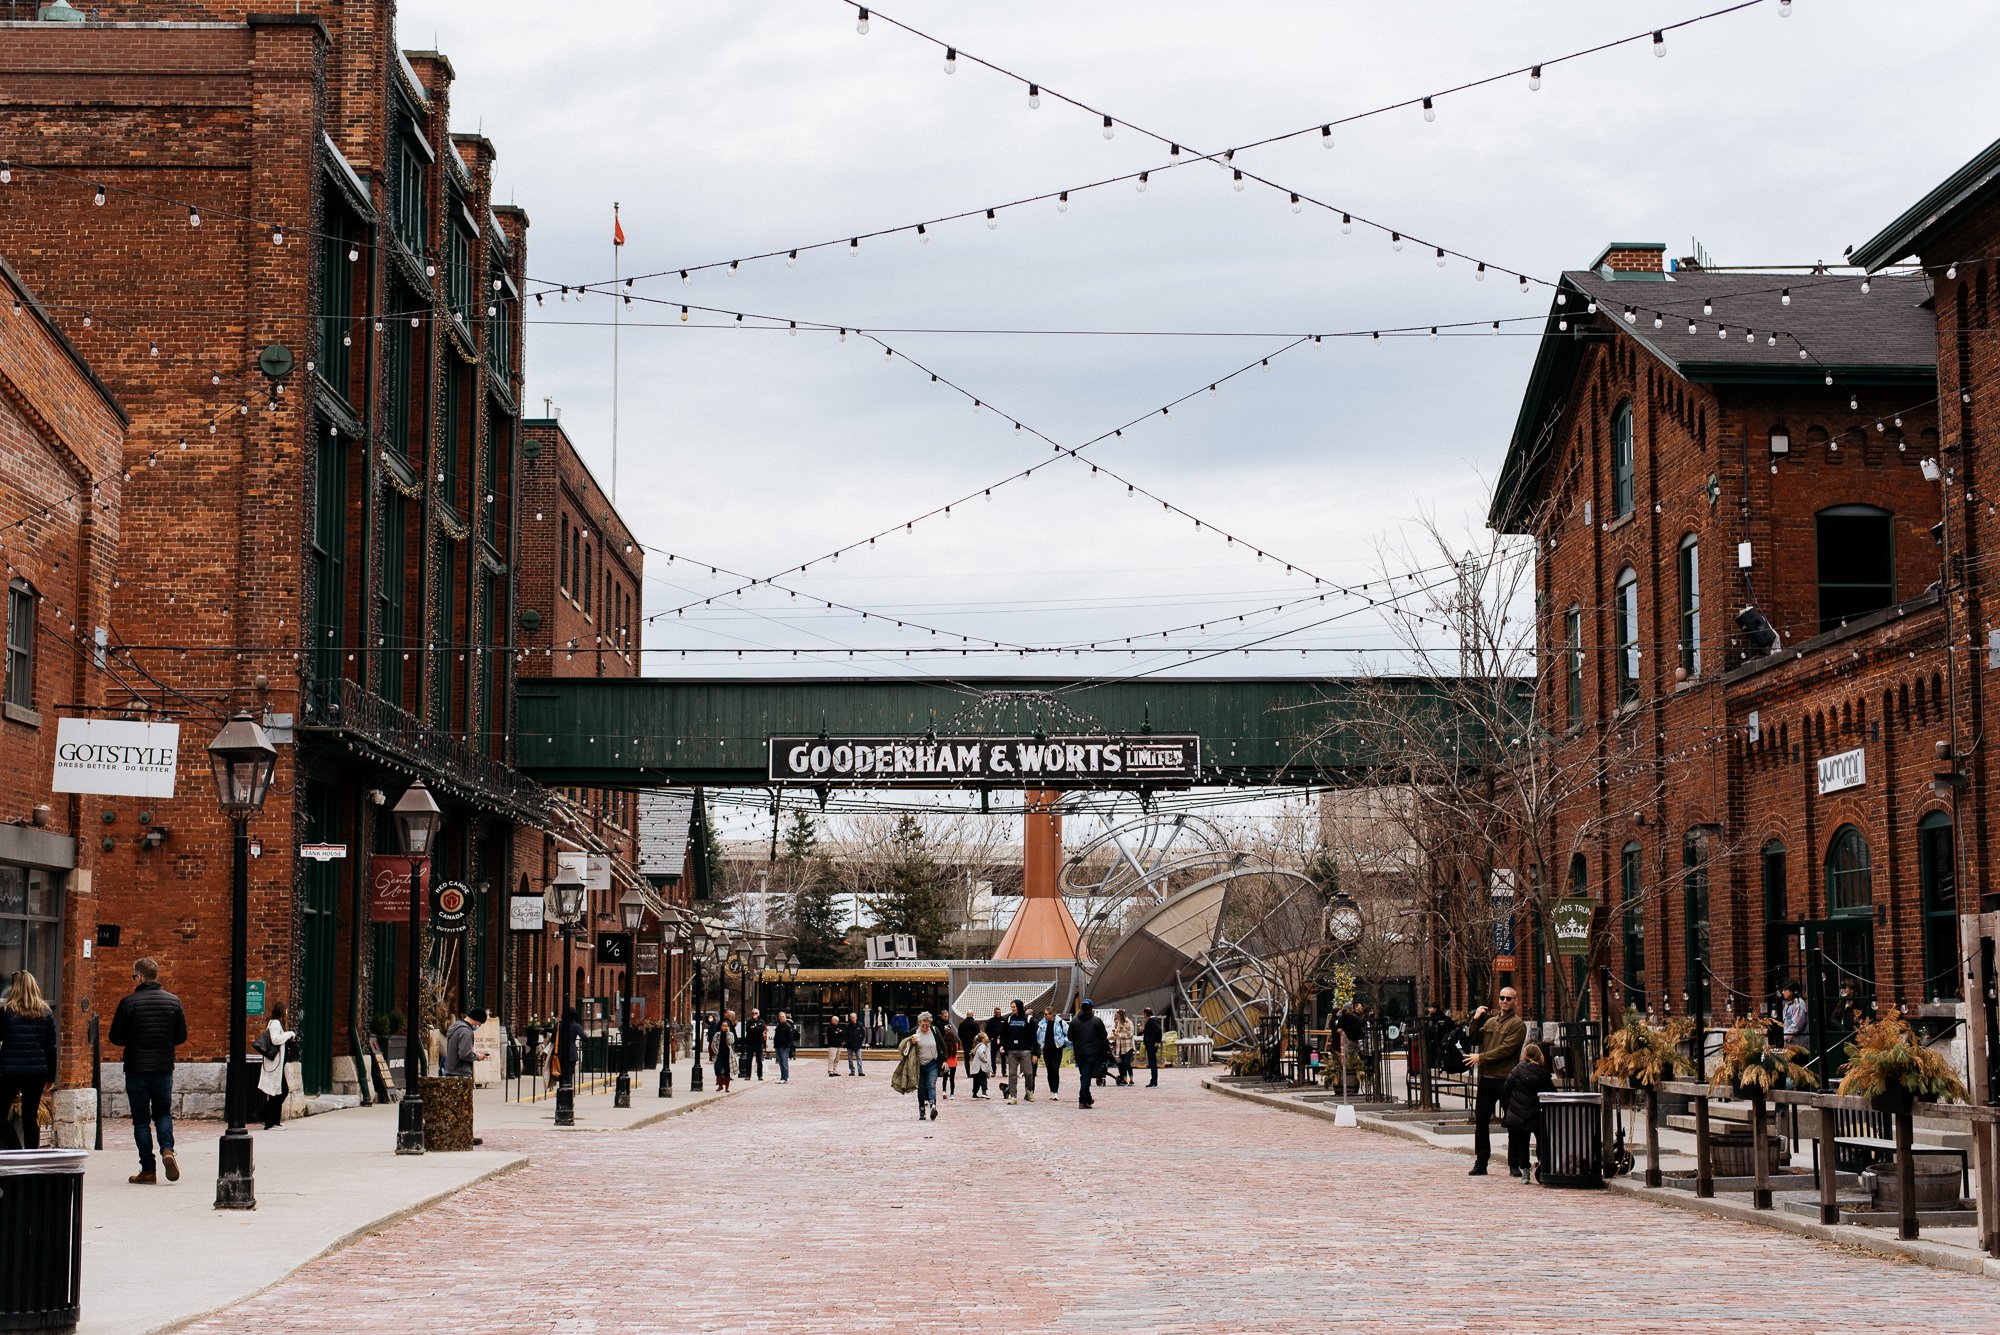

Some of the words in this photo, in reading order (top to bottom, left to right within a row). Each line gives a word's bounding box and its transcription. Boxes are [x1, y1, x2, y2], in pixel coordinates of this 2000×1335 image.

[60, 743, 173, 766] GOTSTYLE
[788, 745, 981, 773] GOODERHAM
[990, 745, 1015, 772] &
[1016, 744, 1122, 772] WORTS
[1125, 750, 1184, 766] LIMITED
[1843, 775, 1860, 786] CANDLES
[435, 882, 448, 894] RED
[448, 880, 470, 895] CANOE
[438, 911, 465, 920] CANADA
[436, 925, 467, 933] OUTFITTER
